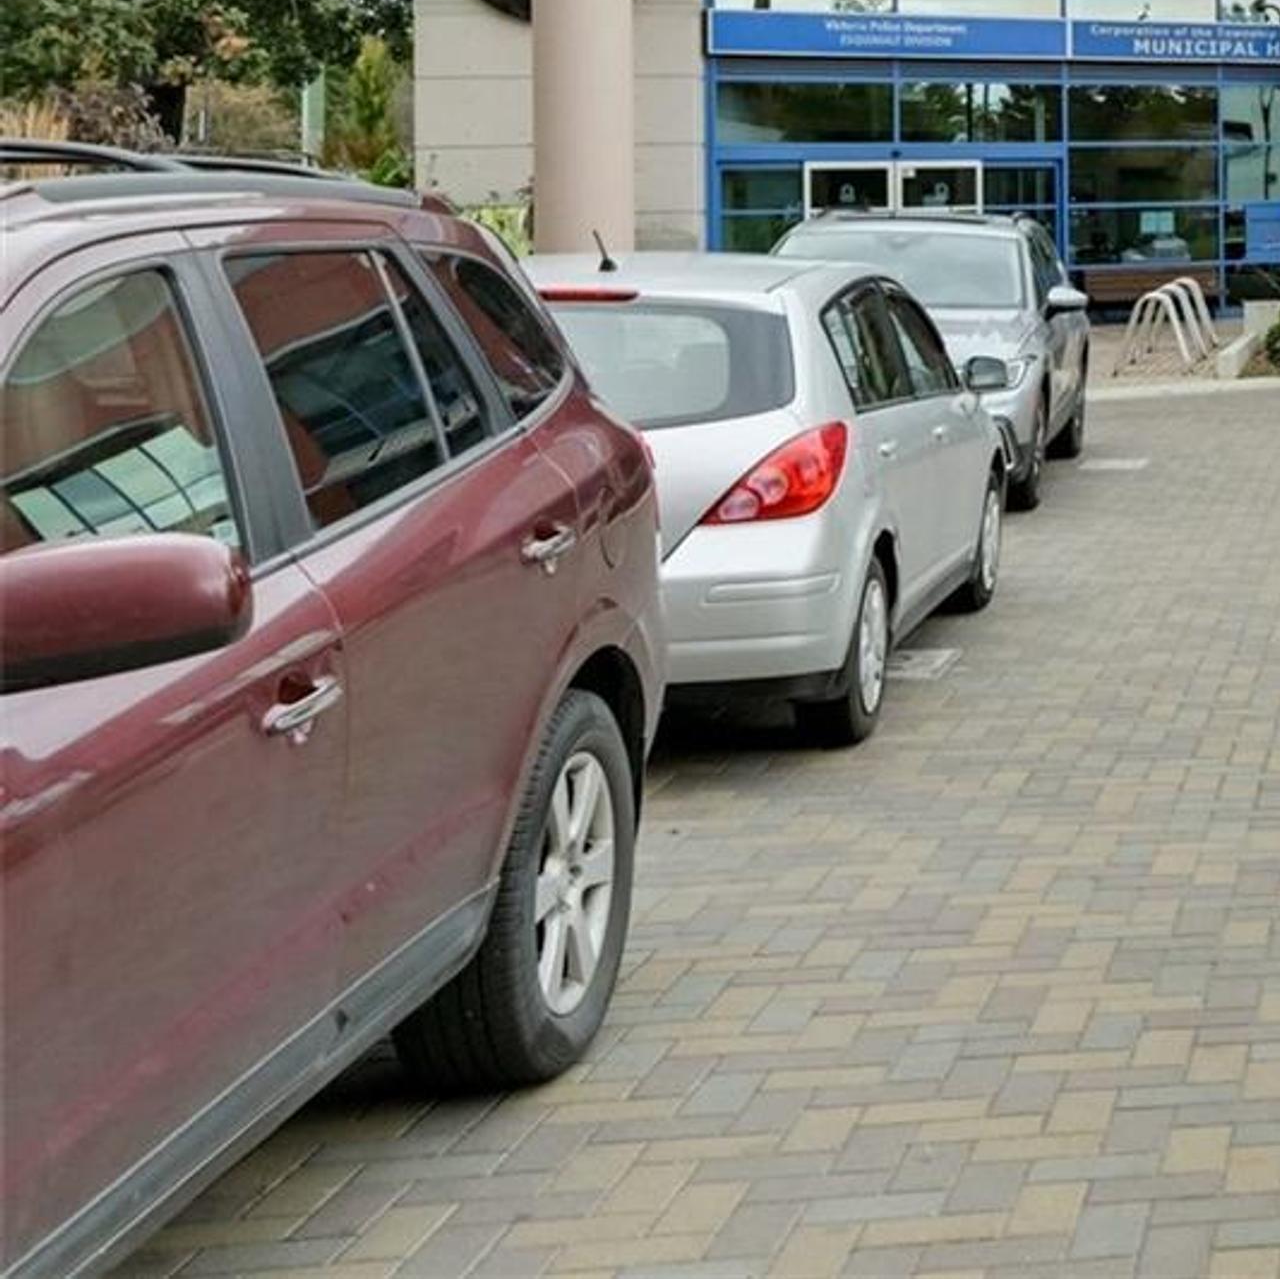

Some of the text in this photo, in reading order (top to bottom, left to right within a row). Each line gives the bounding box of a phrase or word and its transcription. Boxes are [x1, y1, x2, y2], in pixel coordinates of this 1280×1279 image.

[1090, 24, 1170, 37] Corporation
[1174, 26, 1188, 37] of
[1191, 26, 1212, 38] the
[1132, 39, 1259, 57] MUNICIPAL
